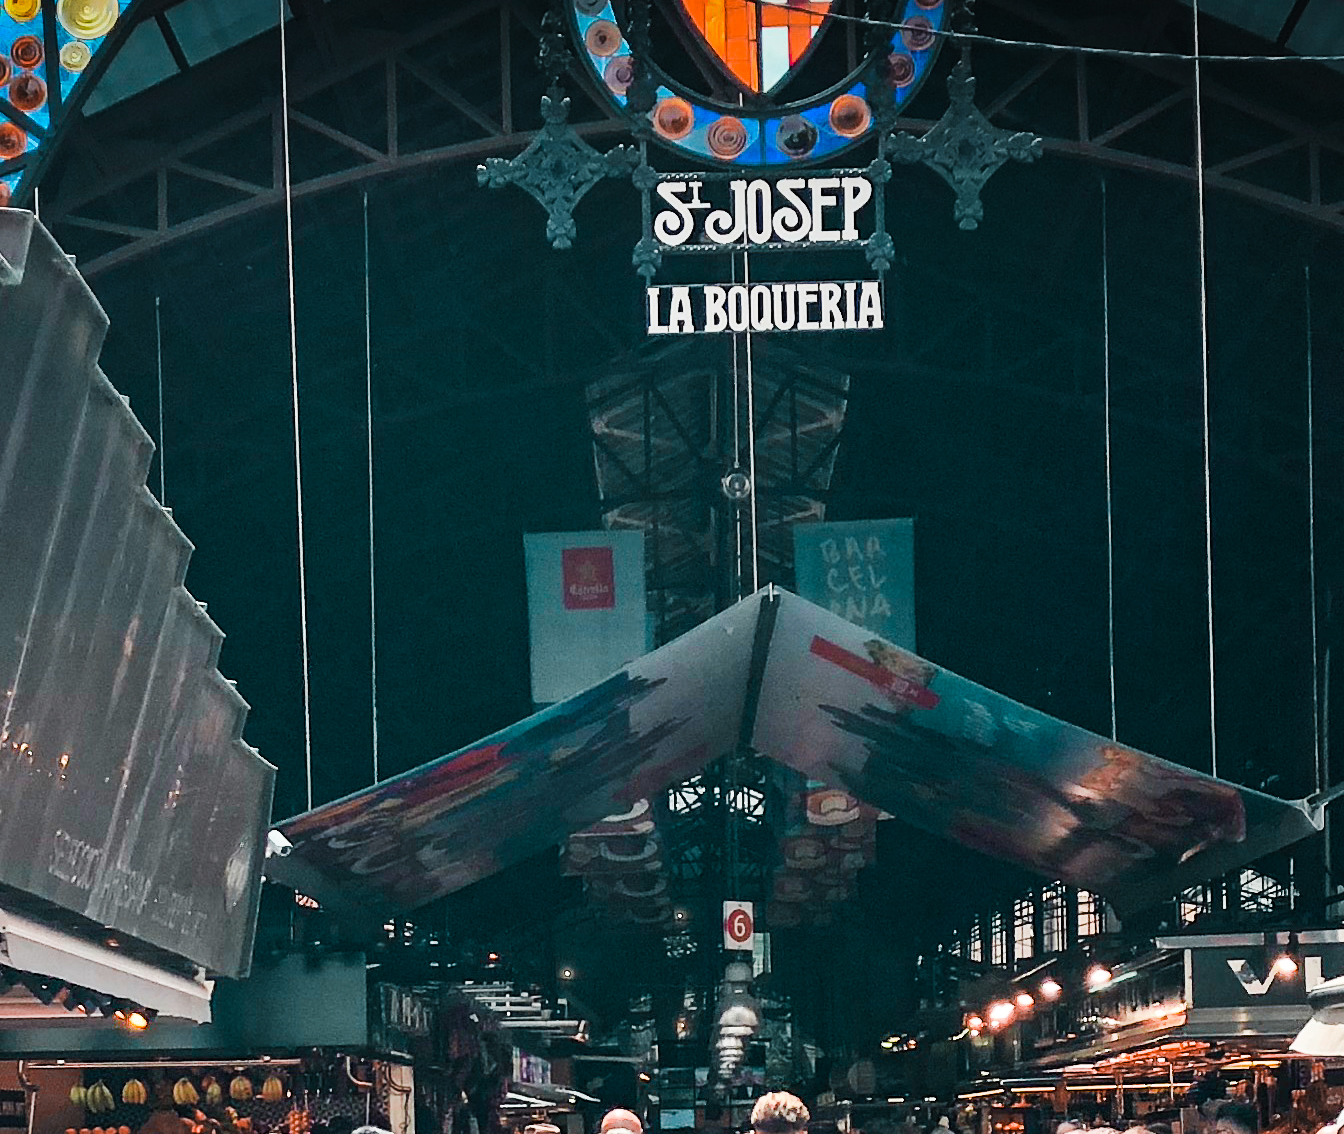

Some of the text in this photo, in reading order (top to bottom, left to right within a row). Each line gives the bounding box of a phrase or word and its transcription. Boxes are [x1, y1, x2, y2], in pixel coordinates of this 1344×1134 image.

[705, 176, 873, 244] JOSEP
[647, 281, 883, 333] LA BOQUERIA
[734, 914, 746, 937] 6
